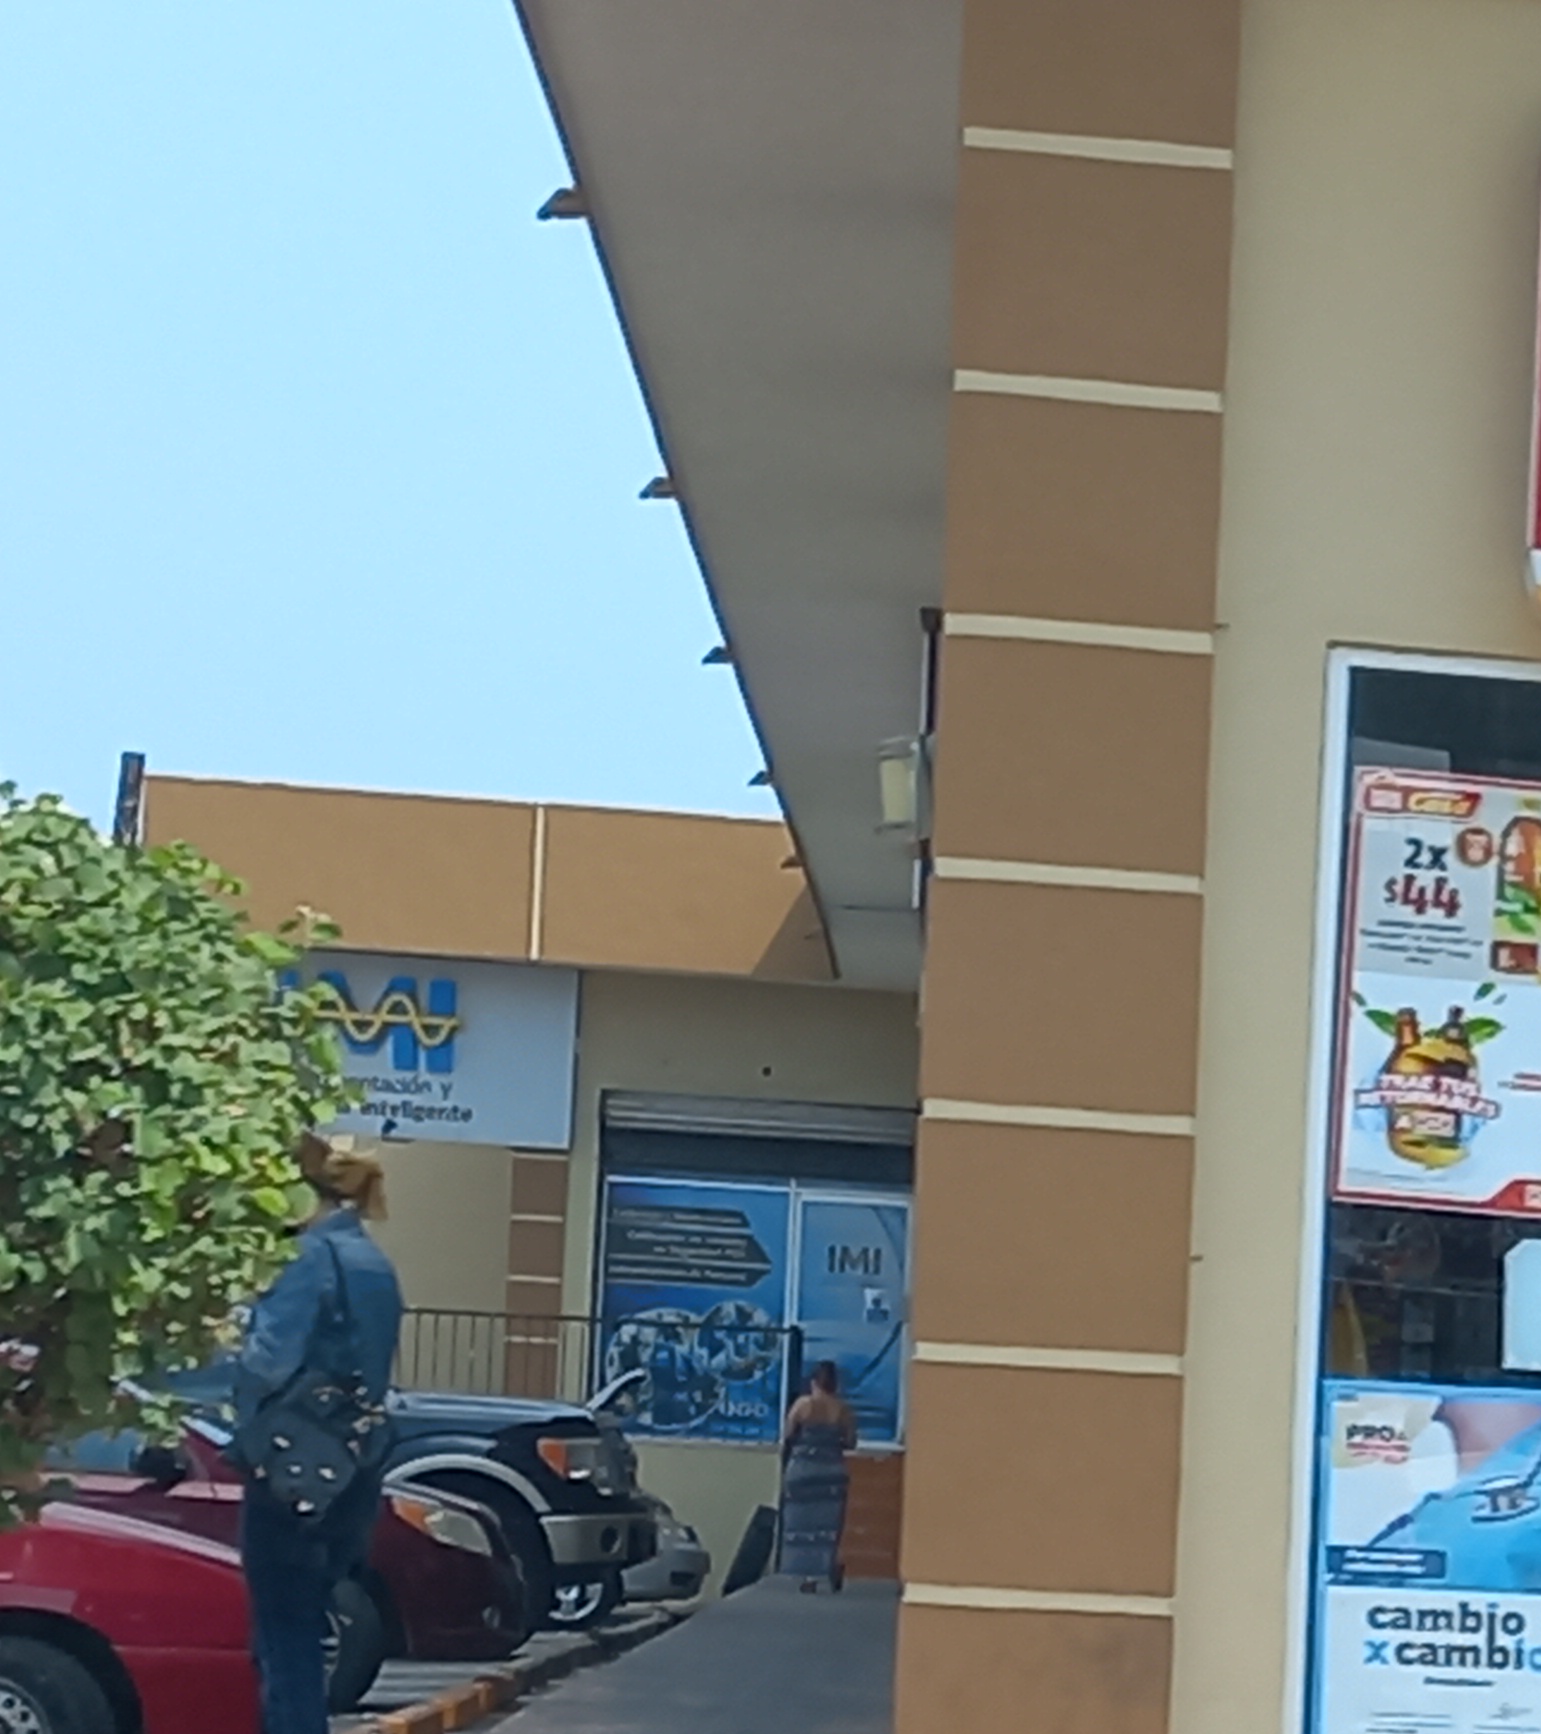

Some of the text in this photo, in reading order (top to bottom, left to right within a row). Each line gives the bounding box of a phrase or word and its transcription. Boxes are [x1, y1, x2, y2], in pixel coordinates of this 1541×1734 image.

[1383, 873, 1462, 918] $44
[827, 1245, 882, 1276] IMI
[1366, 1601, 1526, 1648] cambio
